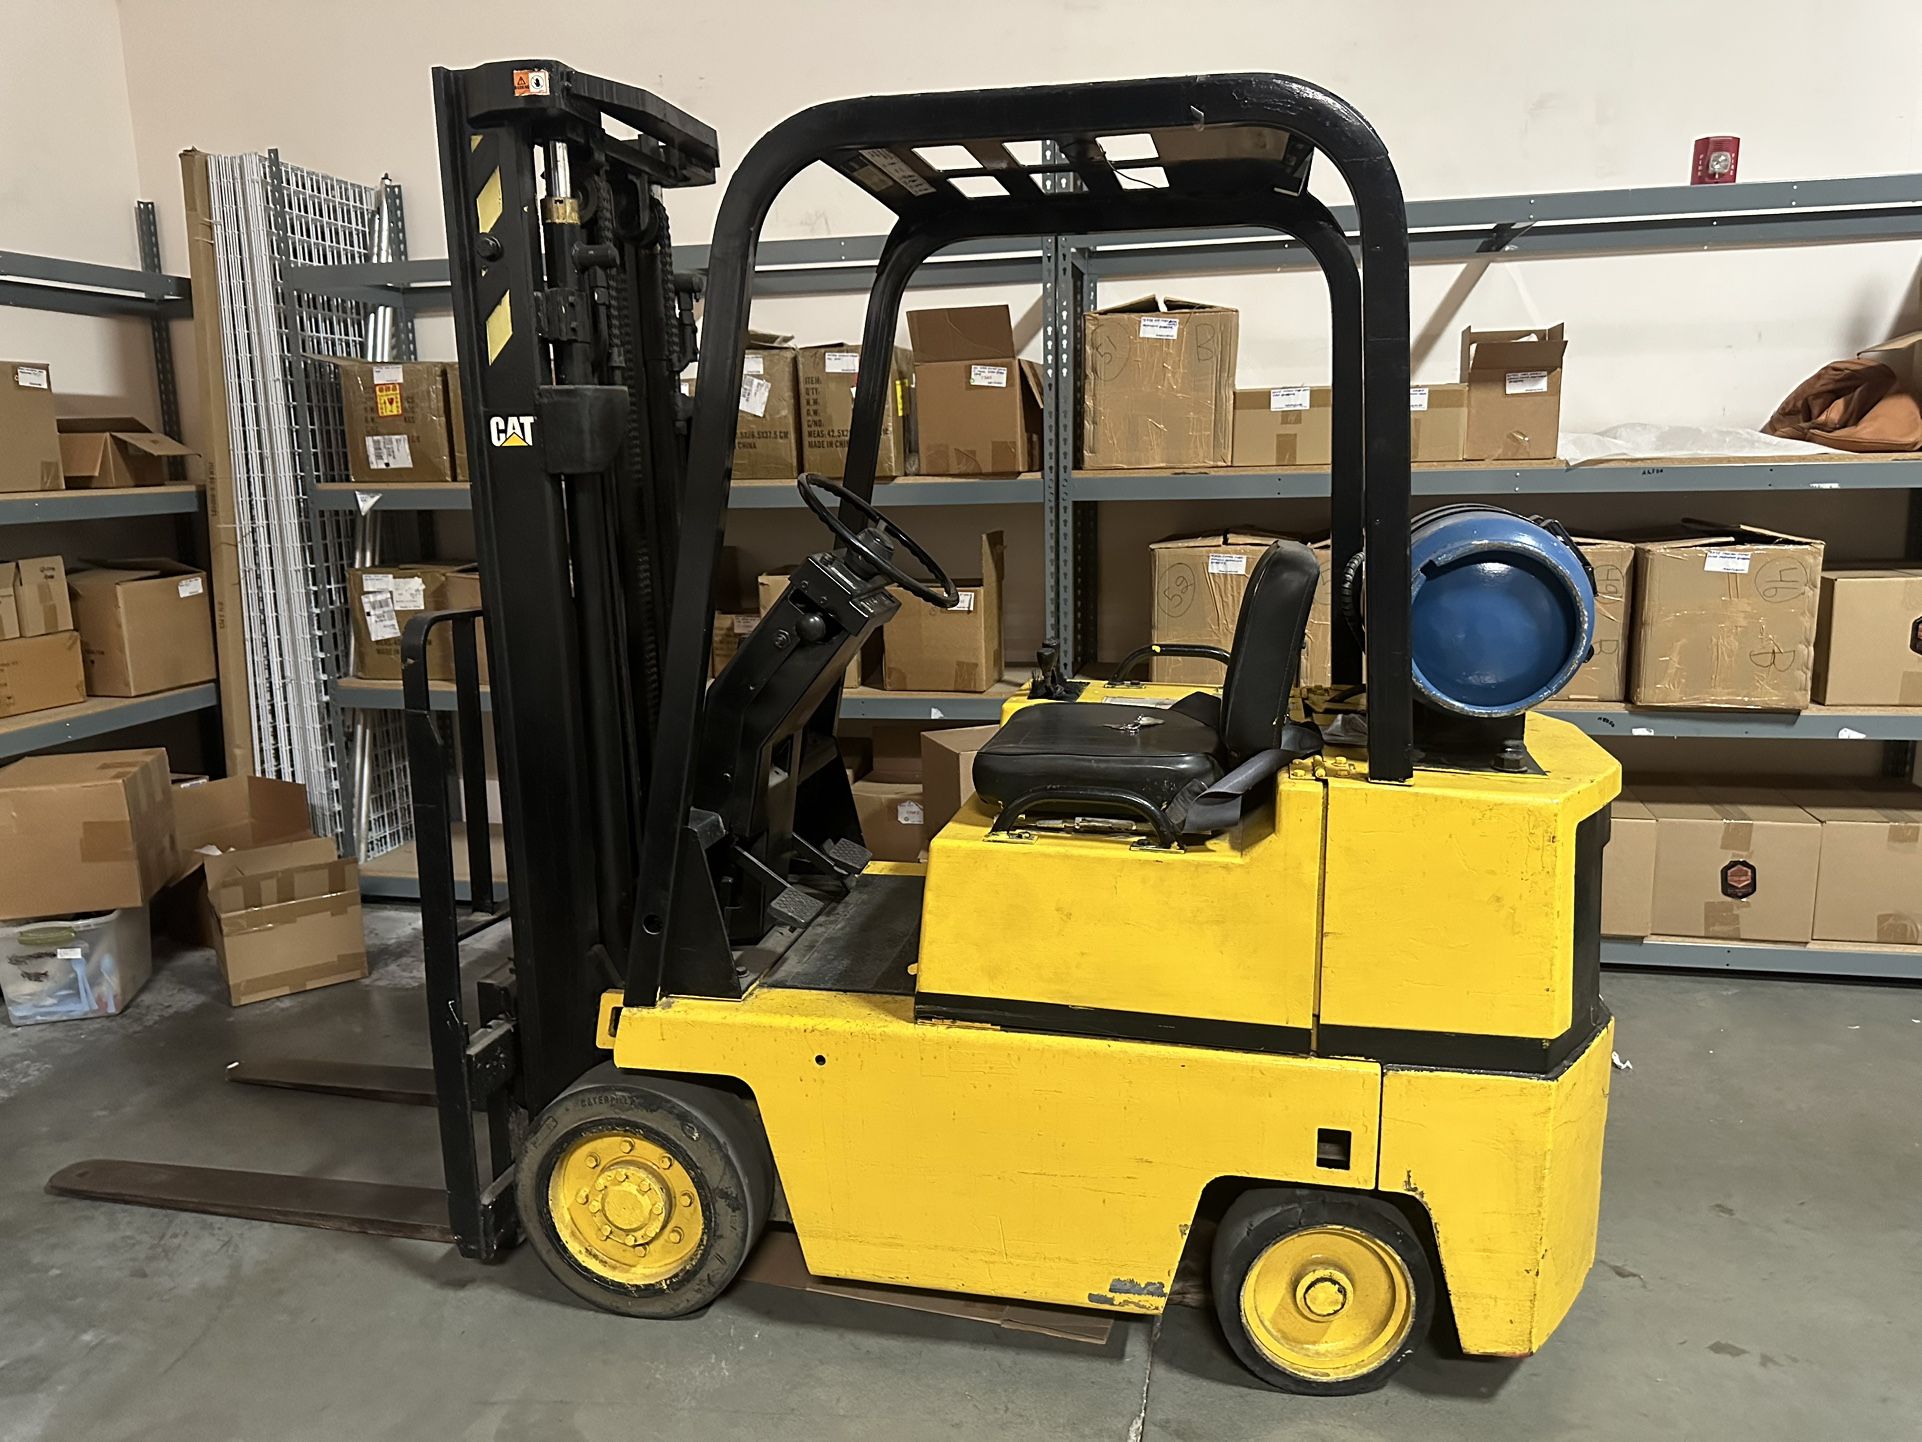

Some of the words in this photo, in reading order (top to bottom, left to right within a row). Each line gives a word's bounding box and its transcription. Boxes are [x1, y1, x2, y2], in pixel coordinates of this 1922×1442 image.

[1195, 323, 1216, 363] B
[490, 416, 535, 447] CAT
[807, 440, 826, 449] MADE
[826, 440, 834, 449] IN
[834, 439, 850, 449] CHIN
[827, 429, 849, 438] 42.5X2
[1749, 648, 1796, 673] B
